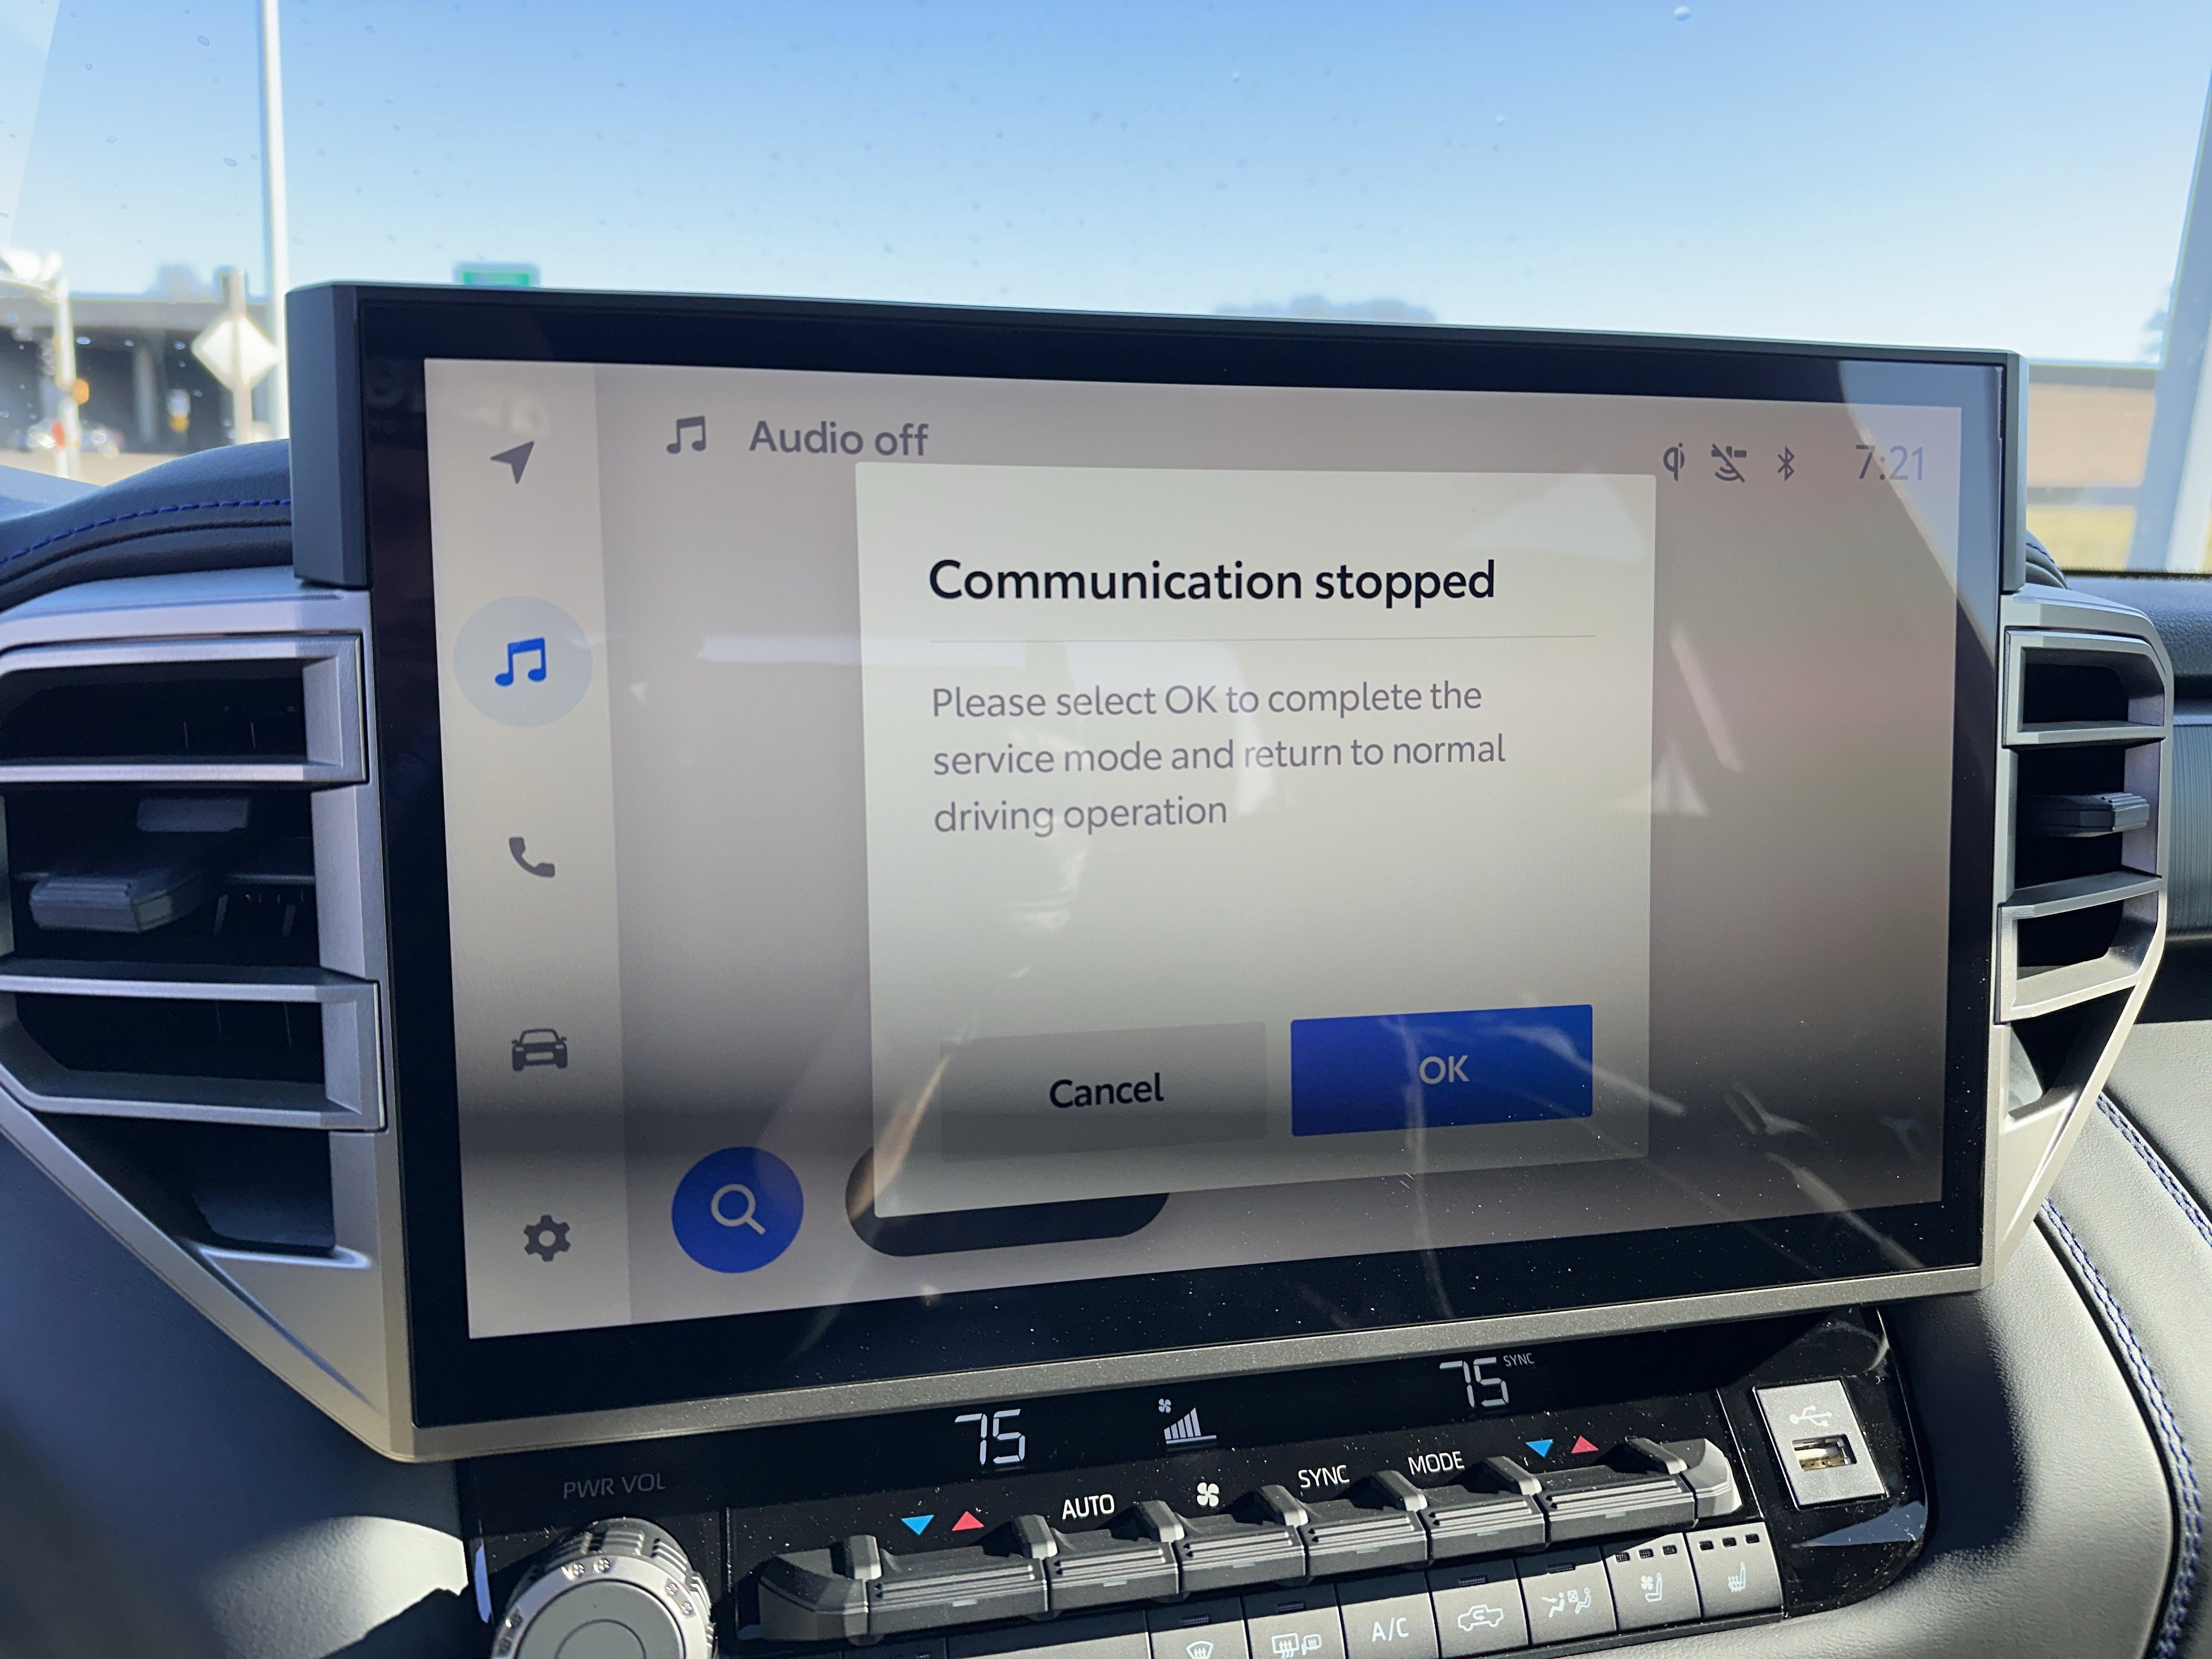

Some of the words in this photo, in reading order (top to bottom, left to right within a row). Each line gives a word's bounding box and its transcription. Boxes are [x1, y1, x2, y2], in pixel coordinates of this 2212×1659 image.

[749, 420, 864, 455] Audio
[874, 422, 929, 456] off
[1855, 444, 1924, 482] 7:21
[929, 559, 1302, 600] Communication
[1315, 559, 1494, 609] stopped
[933, 687, 1046, 717] Please
[1056, 685, 1157, 716] select
[1165, 685, 1218, 714] OK
[1226, 686, 1260, 714] to
[1268, 681, 1422, 719] complete
[1430, 680, 1482, 709] the
[934, 743, 1054, 775] service
[1064, 741, 1163, 772] mode
[1171, 738, 1233, 769] and
[1244, 741, 1342, 768] return
[1351, 738, 1384, 766] to
[1393, 733, 1506, 764] normal
[934, 800, 1054, 838] driving
[1063, 795, 1227, 836] operation
[1418, 1054, 1469, 1085] OK
[1049, 1072, 1164, 1109] Cancel
[1438, 1356, 1510, 1409] 75
[1502, 1351, 1536, 1368] SYNC
[953, 1408, 1026, 1466] 75
[1297, 1464, 1350, 1489] SYNC
[1408, 1450, 1465, 1475] MODE
[562, 1477, 615, 1500] PWR
[621, 1472, 667, 1496] VOL
[1062, 1493, 1116, 1521] AUTO
[1371, 1616, 1410, 1643] A/C
